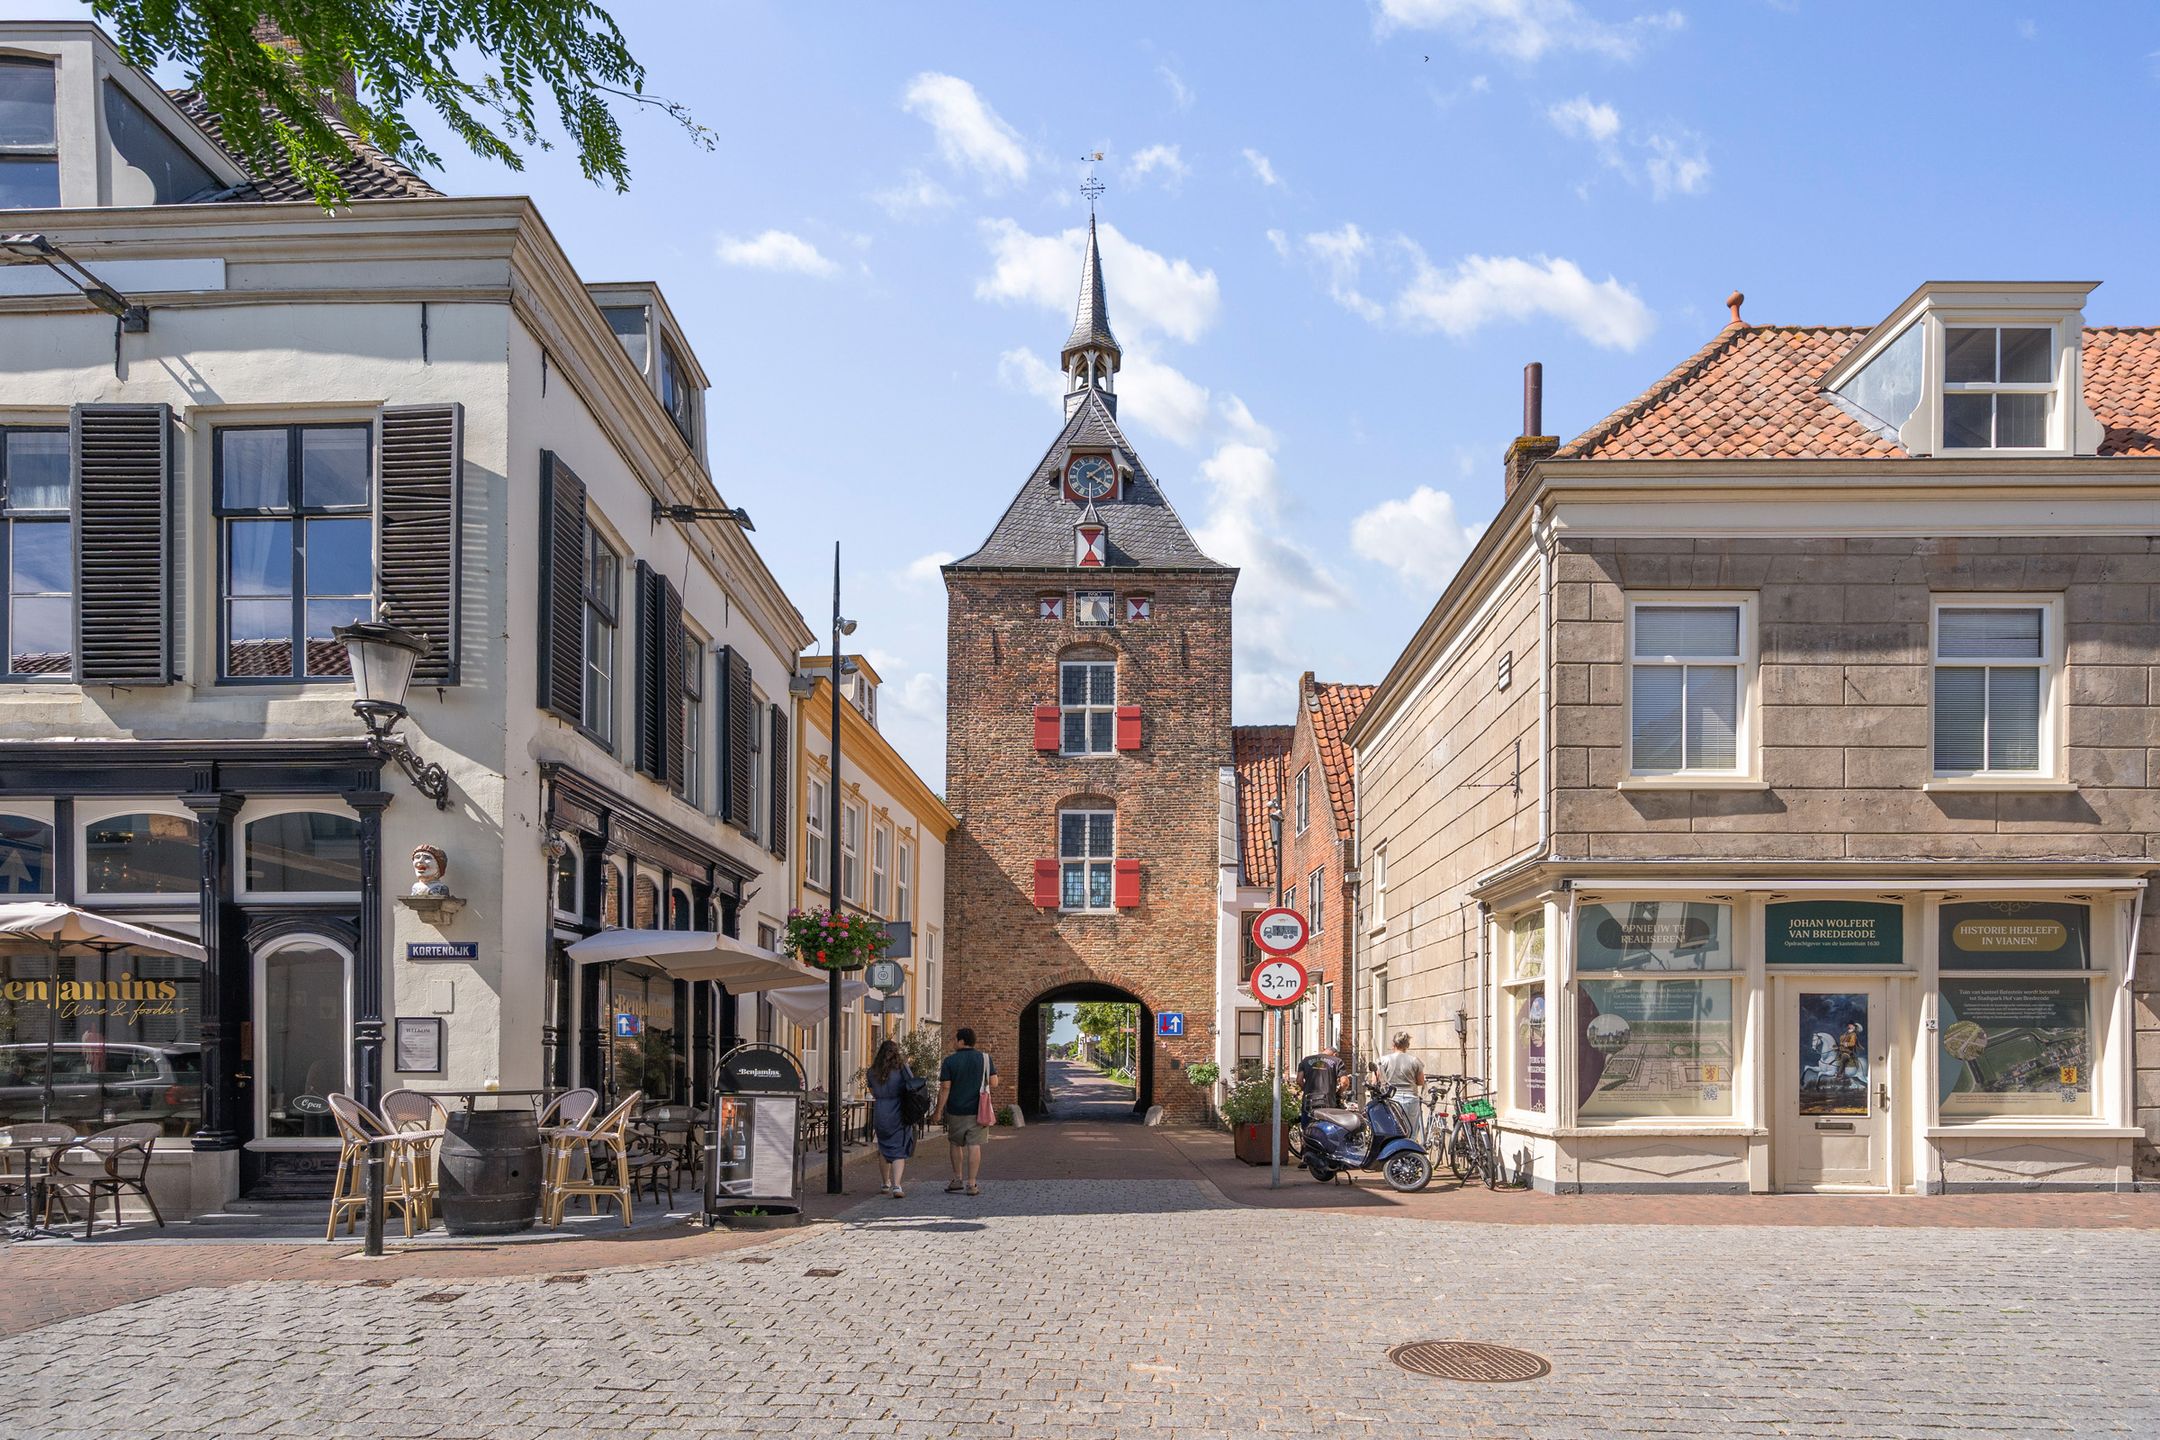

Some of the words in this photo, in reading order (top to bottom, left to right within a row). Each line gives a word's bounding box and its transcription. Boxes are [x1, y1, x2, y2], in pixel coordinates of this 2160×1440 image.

[1621, 924, 1672, 934] OPNIEUW
[1672, 924, 1686, 933] TE
[1788, 919, 1824, 929] JOHAN
[1826, 919, 1876, 928] WOLFERT
[1788, 930, 1810, 939] VAN
[1812, 930, 1876, 939] BREDERODE
[1960, 926, 2007, 935] HISTORIE
[2009, 926, 2060, 935] HERLEEFT
[1982, 937, 1993, 945] IN
[1996, 937, 2038, 945] VIANEN!
[412, 946, 470, 957] KORTENDIJK
[0, 972, 178, 1010] enjamins
[110, 1001, 129, 1017] &
[738, 1068, 780, 1077] Benjamins
[301, 1099, 322, 1109] Open
